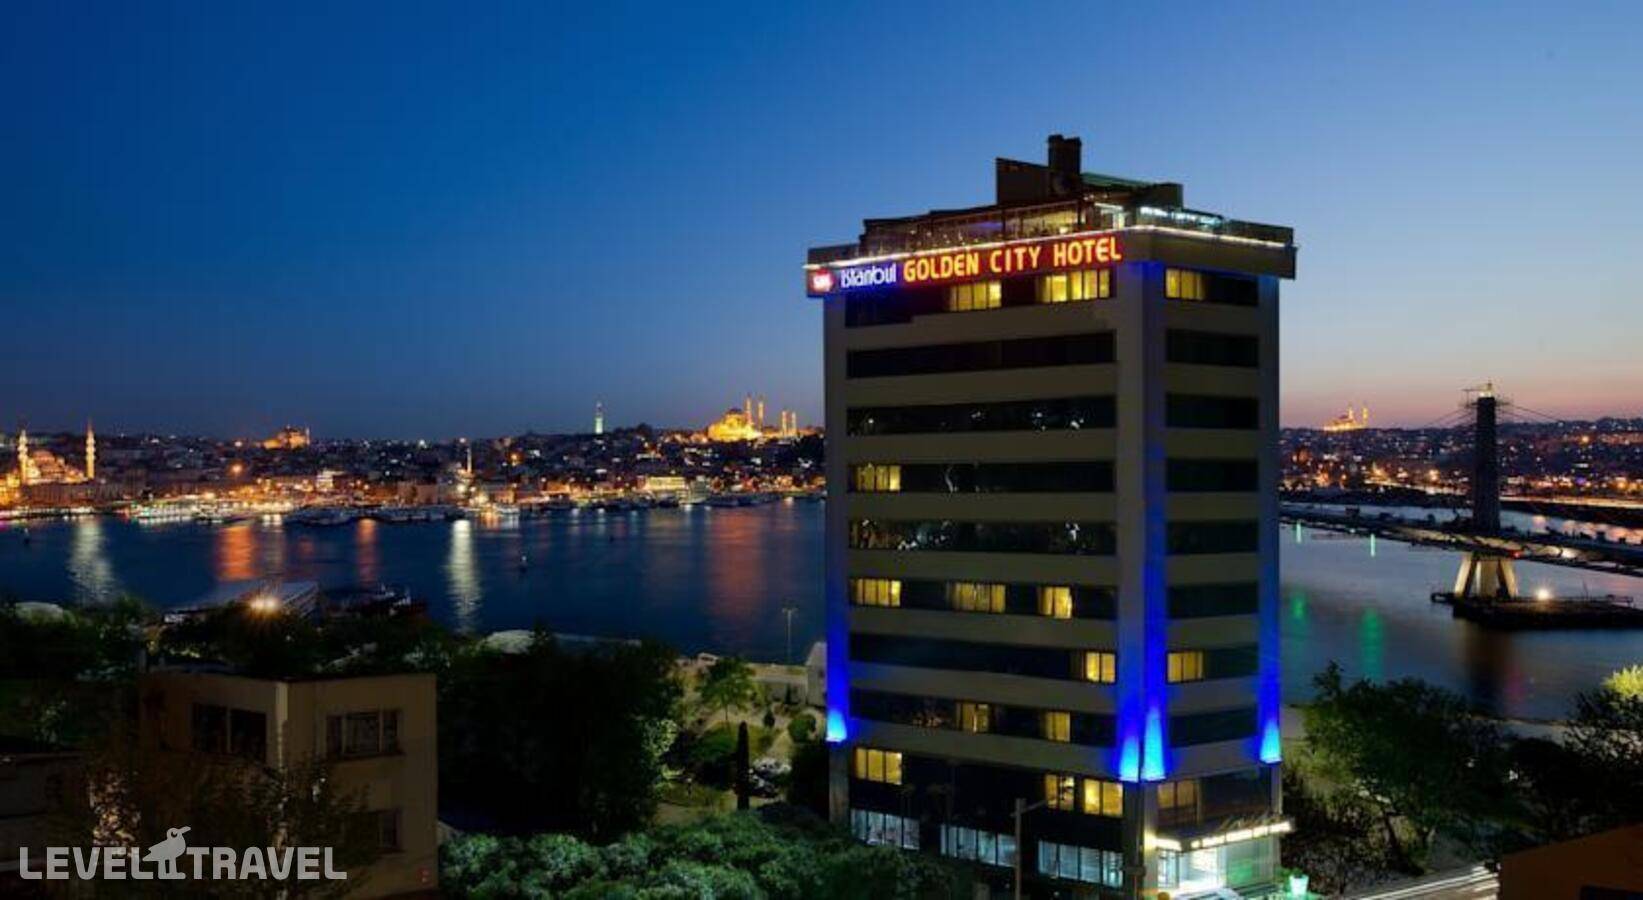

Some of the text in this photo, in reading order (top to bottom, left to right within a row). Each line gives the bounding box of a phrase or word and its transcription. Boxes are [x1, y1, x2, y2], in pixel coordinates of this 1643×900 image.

[903, 252, 978, 282] GOLDEN
[990, 246, 1041, 273] CITY
[1053, 236, 1122, 267] HOTEL
